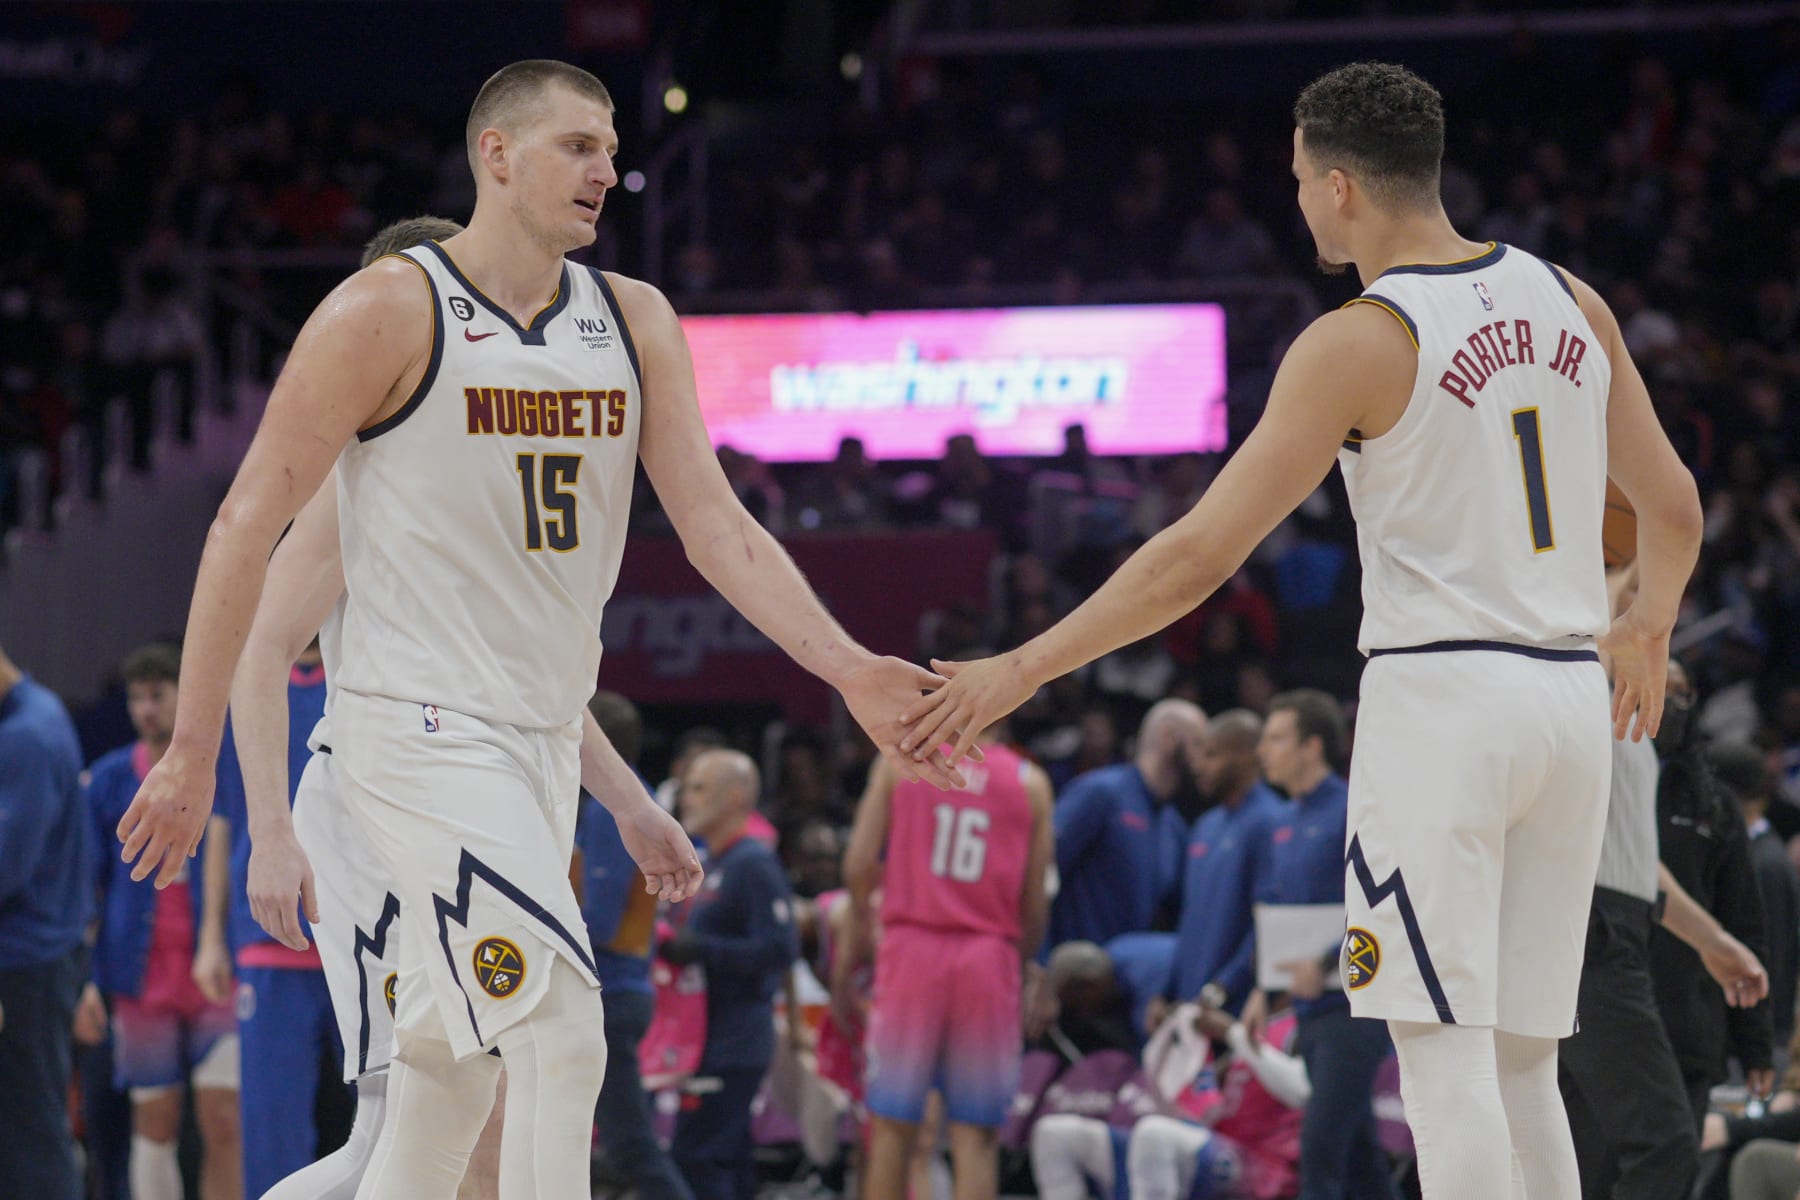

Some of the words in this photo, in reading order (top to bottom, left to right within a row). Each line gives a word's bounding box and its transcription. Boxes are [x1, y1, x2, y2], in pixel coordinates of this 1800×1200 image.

[451, 299, 470, 319] 6
[574, 317, 607, 333] WU
[579, 335, 613, 343] Western
[587, 342, 612, 350] Union
[1439, 319, 1535, 408] PORTER
[1548, 329, 1587, 387] JR.
[464, 388, 627, 438] NUGGETS
[516, 452, 584, 552] 15
[1511, 406, 1555, 553] 1
[930, 803, 991, 884] 16
